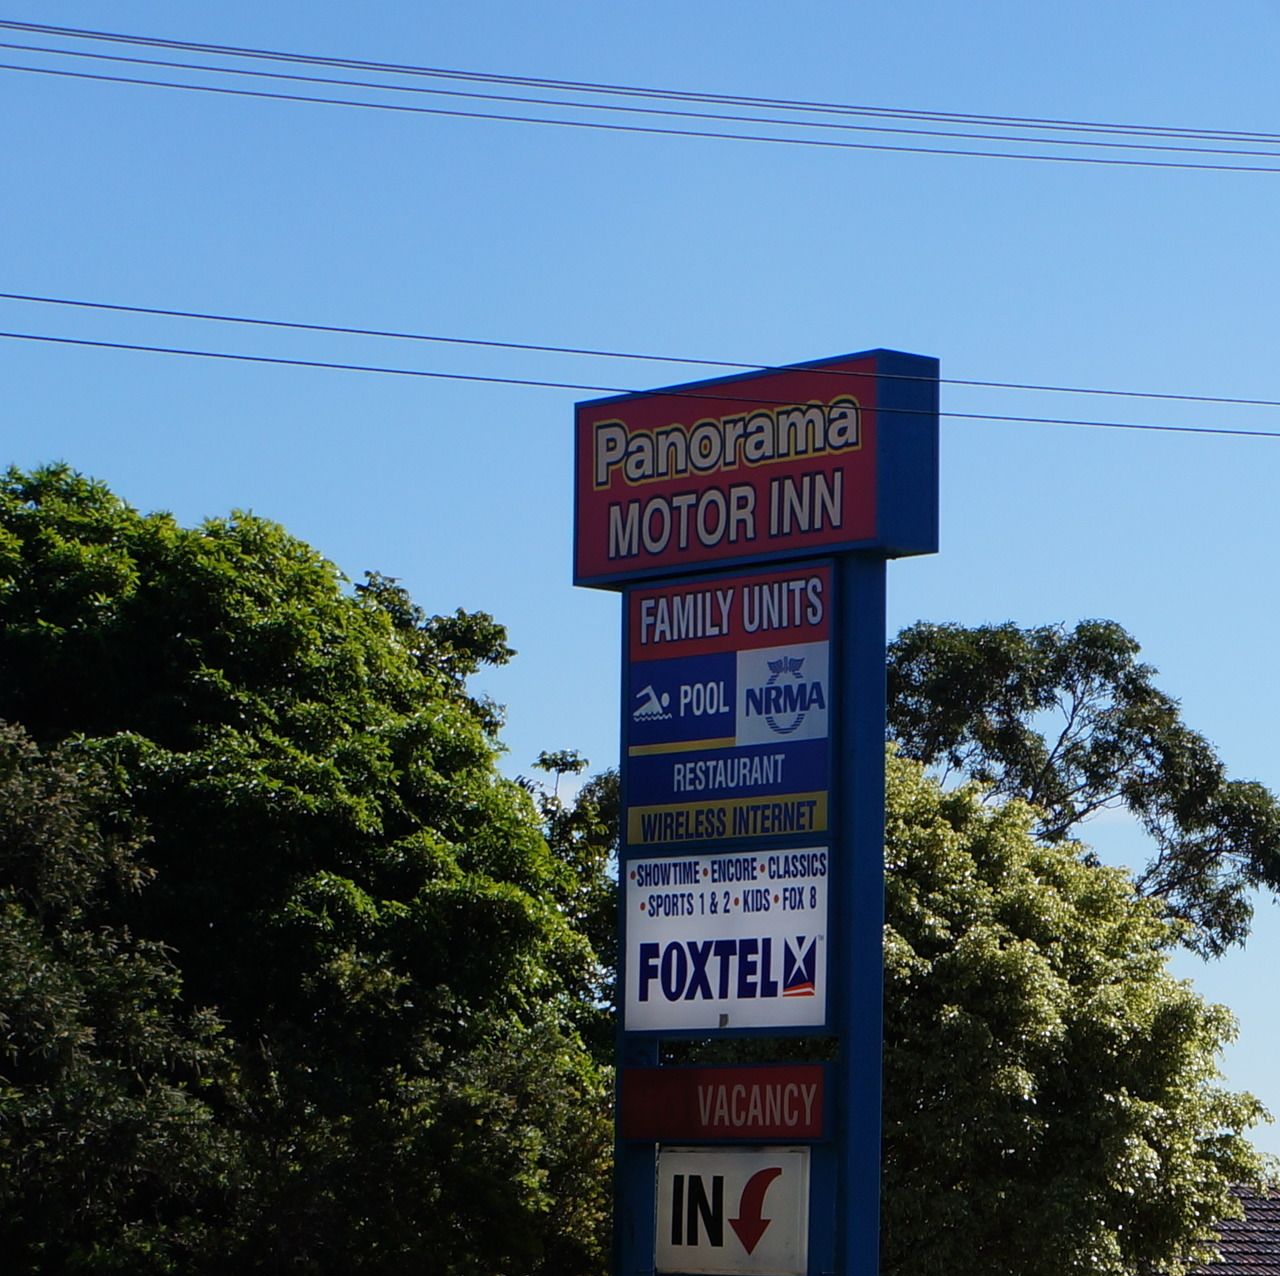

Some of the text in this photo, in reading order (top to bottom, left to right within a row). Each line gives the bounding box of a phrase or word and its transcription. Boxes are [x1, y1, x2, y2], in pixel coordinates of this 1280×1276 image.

[594, 394, 861, 491] Panorama
[608, 469, 843, 559] MOTOR INN
[640, 577, 823, 645] FAMILY UNITS
[679, 681, 729, 717] POOL
[745, 681, 826, 717] NRMA
[674, 754, 785, 792] RESTAURANT
[641, 801, 817, 842] WIRELESS INTERNET
[637, 852, 826, 887] SHOWTIME ENCORE CLASSICS
[648, 885, 817, 917] SPORTS 1 & 2 KIDS FOX 8
[638, 937, 778, 1001] FOXTEL
[698, 1083, 816, 1127] VACANCY
[671, 1174, 724, 1247] IN
